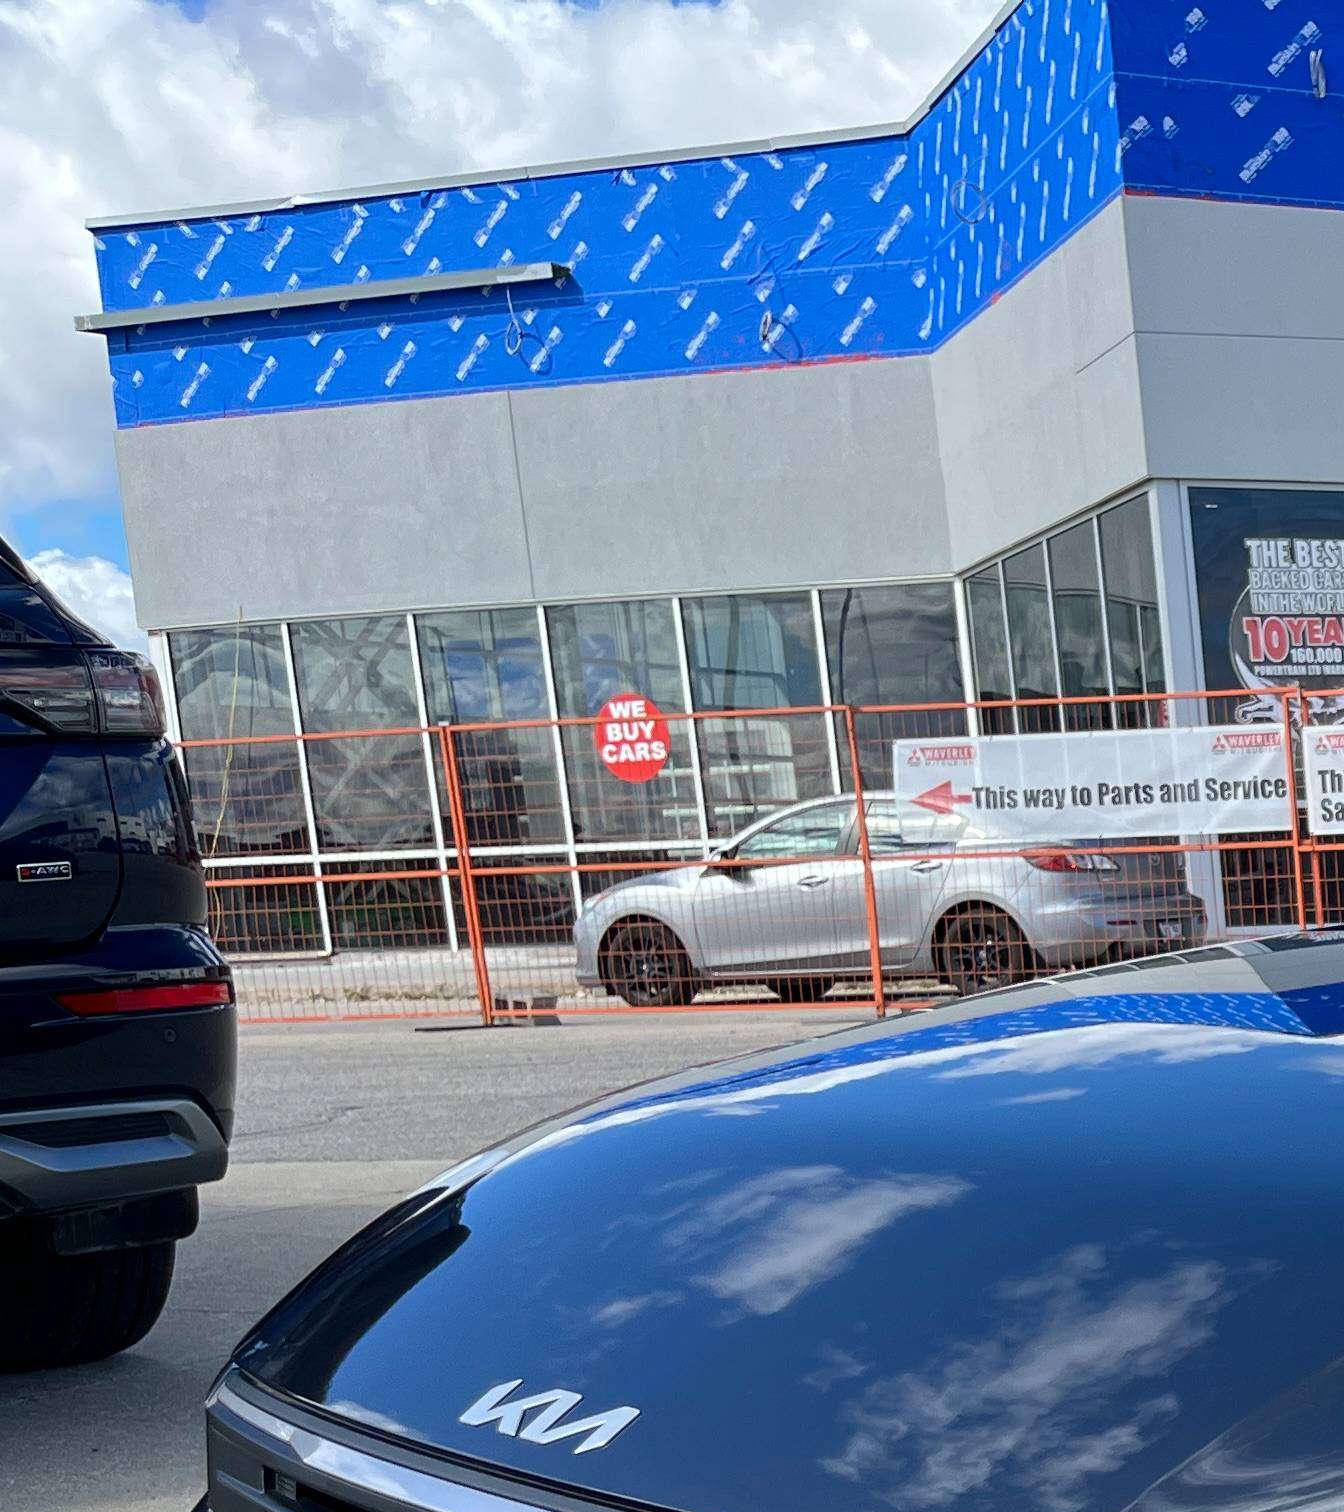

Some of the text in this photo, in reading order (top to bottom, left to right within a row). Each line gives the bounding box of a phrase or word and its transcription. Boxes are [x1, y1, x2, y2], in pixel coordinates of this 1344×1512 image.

[1244, 538, 1291, 568] THE
[1251, 570, 1309, 589] BACKED
[1243, 616, 1289, 662] 10
[609, 700, 648, 719] WE
[606, 720, 655, 742] BUY
[602, 741, 667, 763] CARS
[972, 776, 1287, 810] This way to Parts and Service
[459, 1378, 641, 1455] KIA
